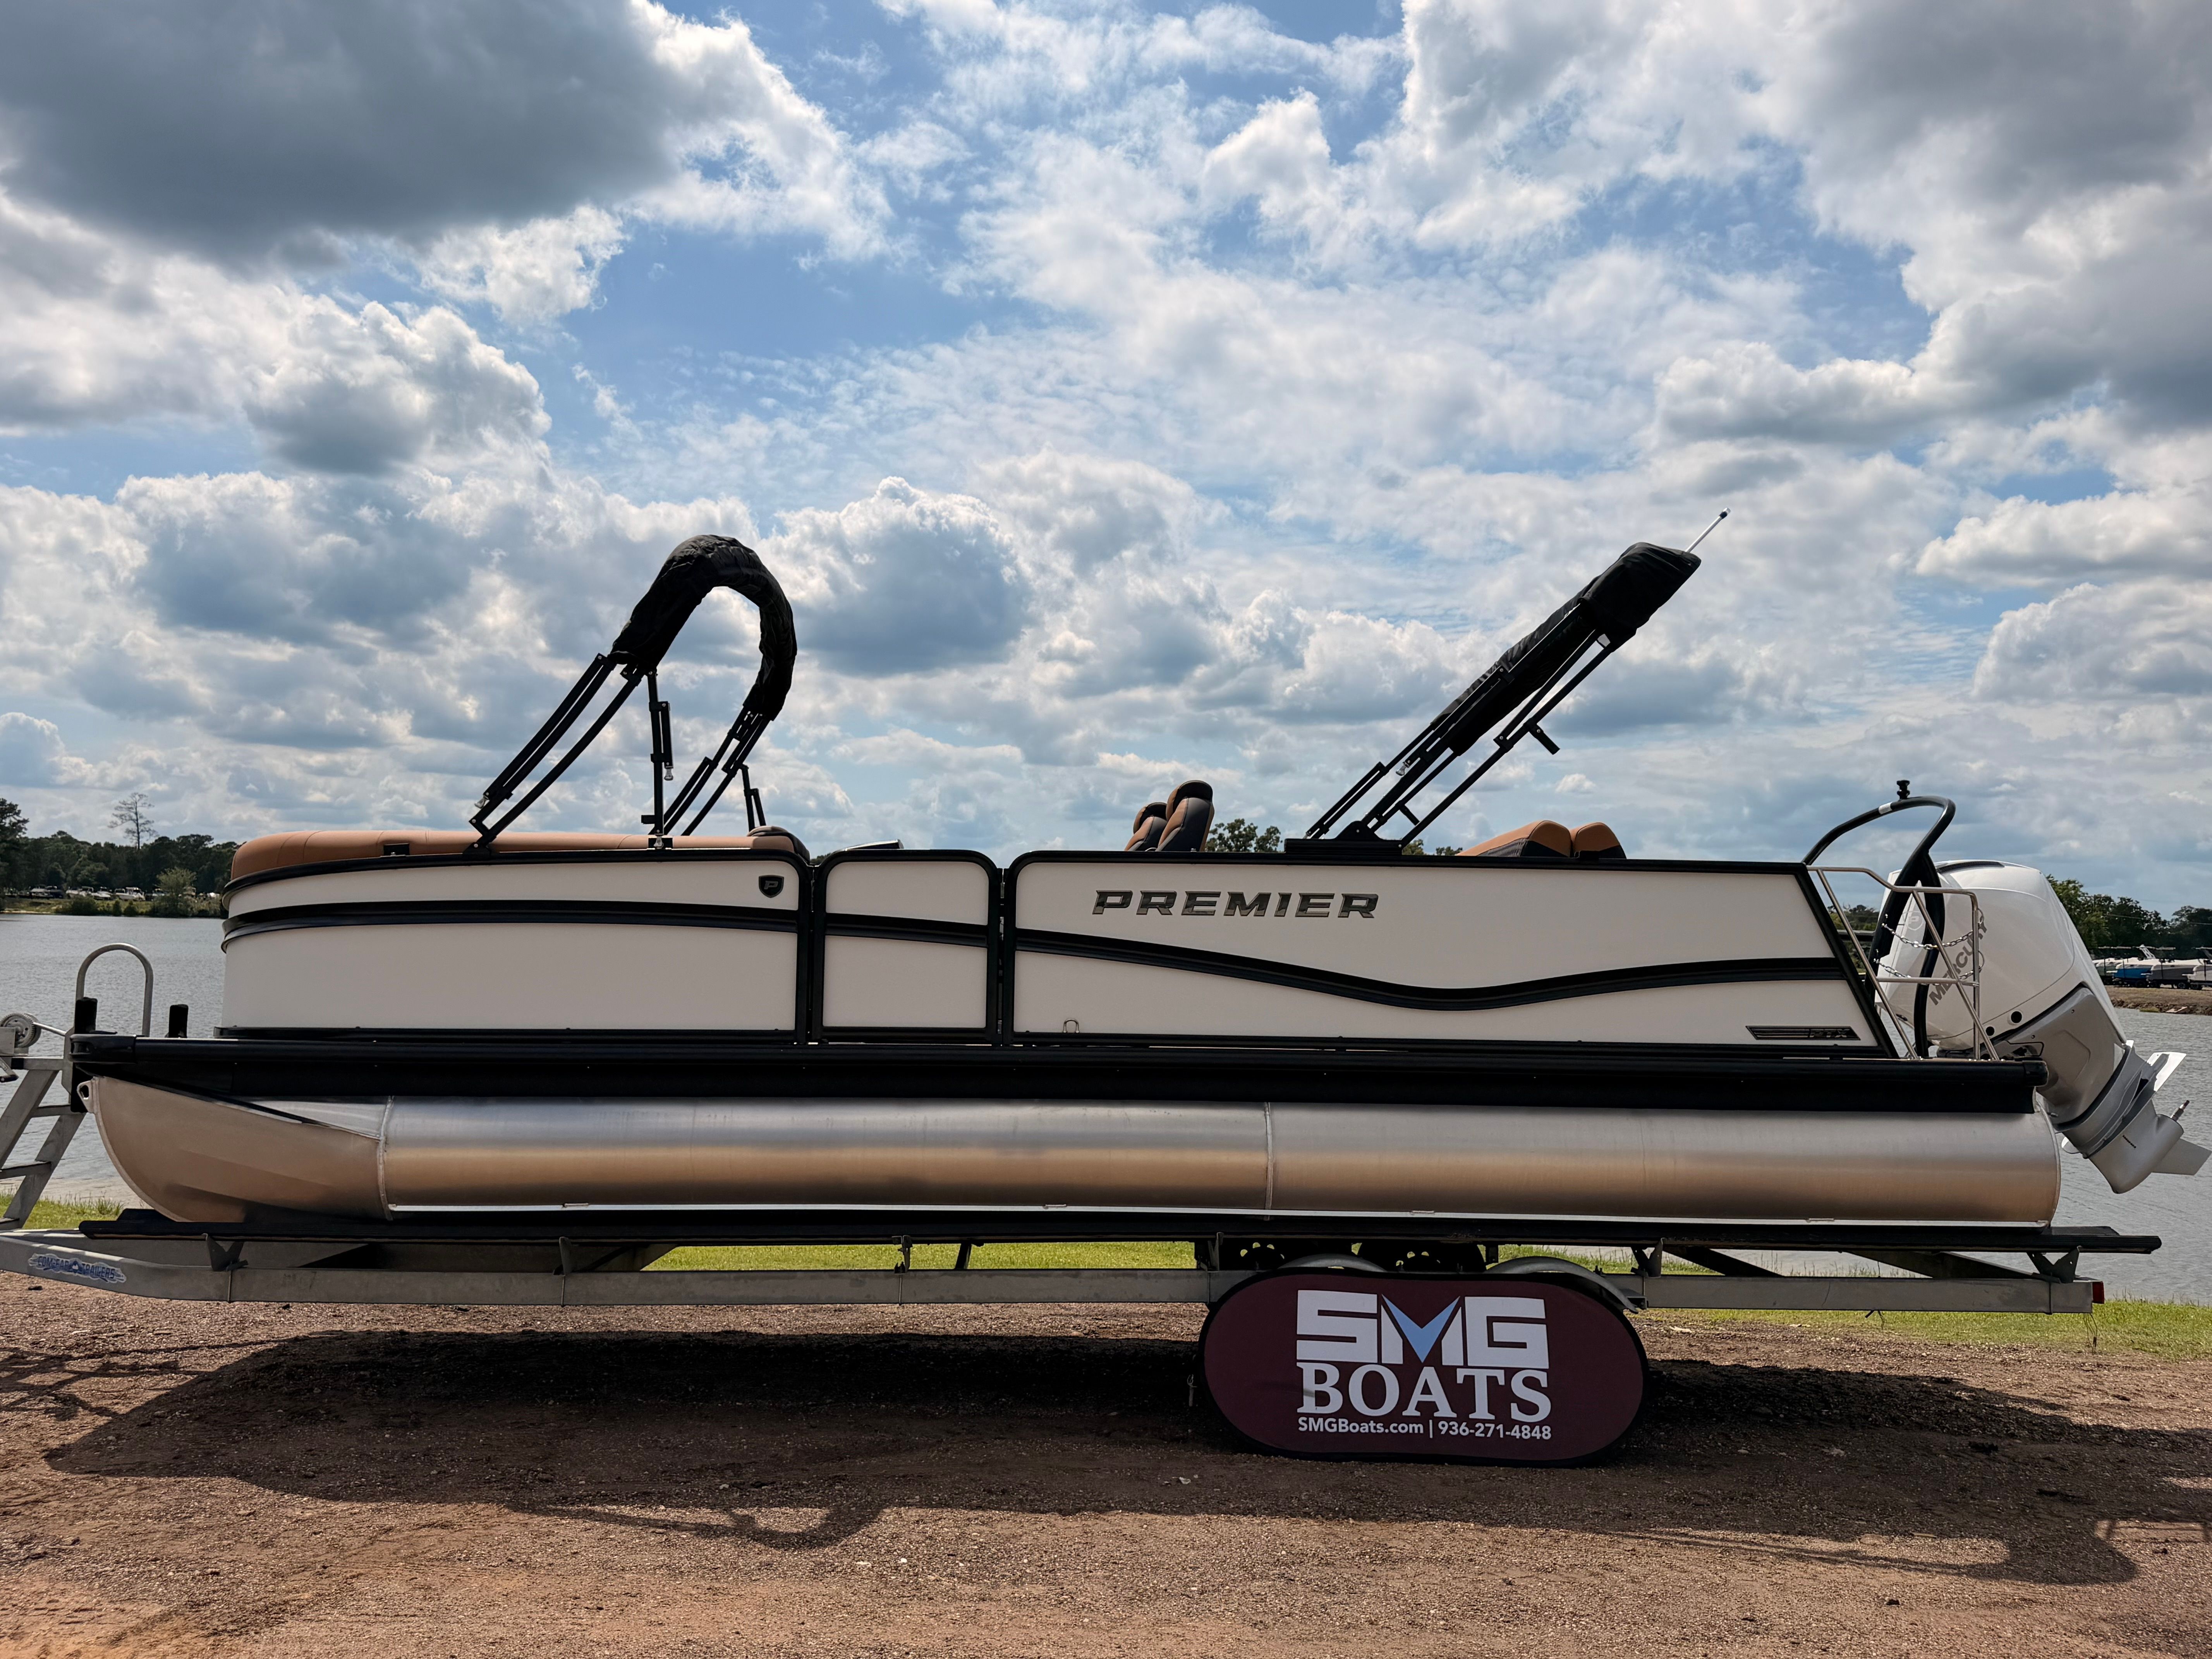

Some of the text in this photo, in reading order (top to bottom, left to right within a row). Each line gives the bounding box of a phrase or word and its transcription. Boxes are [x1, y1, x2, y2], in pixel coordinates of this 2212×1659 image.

[764, 880, 779, 890] P
[1092, 890, 1379, 918] PREMIER
[81, 1263, 115, 1279] TRAILERS
[1297, 1290, 1549, 1369] SMG
[1296, 1362, 1551, 1422] BOATS
[1298, 1417, 1424, 1434] SMGBoats.com
[1438, 1421, 1551, 1440] 936-271-4848
